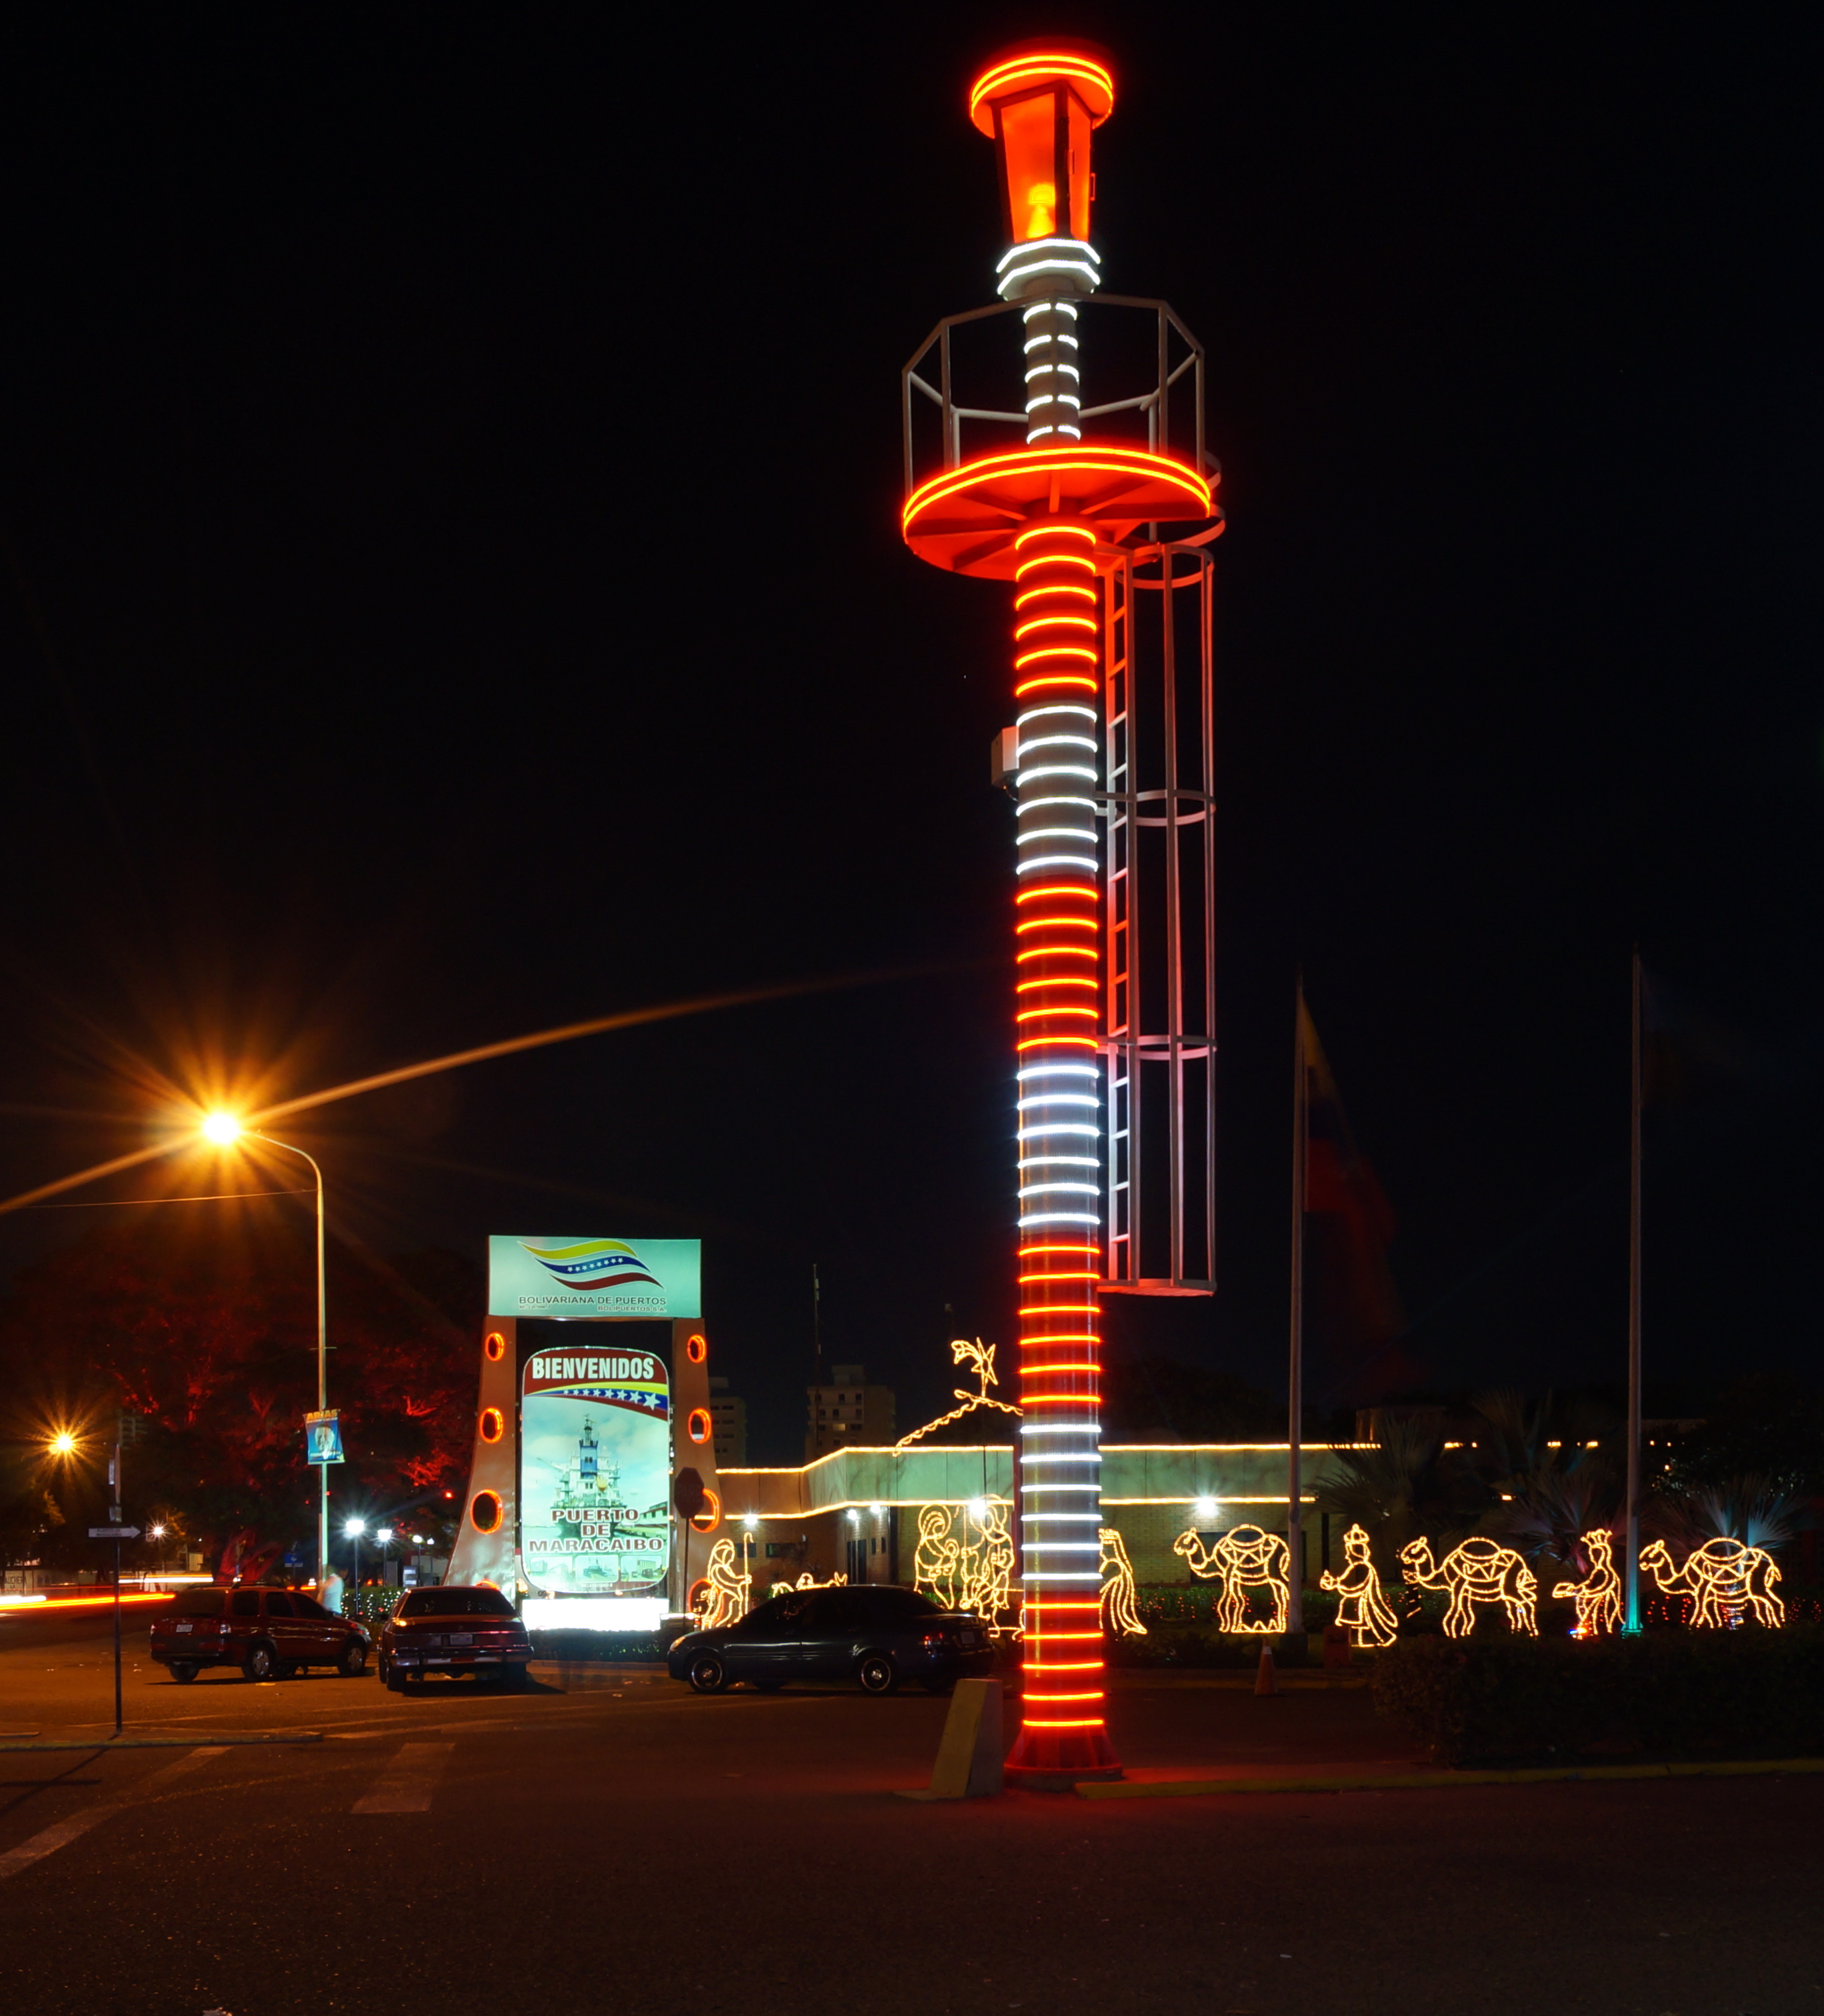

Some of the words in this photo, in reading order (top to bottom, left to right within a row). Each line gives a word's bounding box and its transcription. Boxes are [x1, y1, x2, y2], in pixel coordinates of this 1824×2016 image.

[519, 1296, 595, 1304] BOLIVARIANA
[615, 1297, 666, 1305] PUERTOS
[533, 1357, 654, 1379] BIENVENIDOS
[306, 1409, 338, 1421] ARIAS
[551, 1509, 639, 1522] PUERTO
[582, 1524, 611, 1537] DE
[529, 1538, 663, 1552] MARACAIBO
